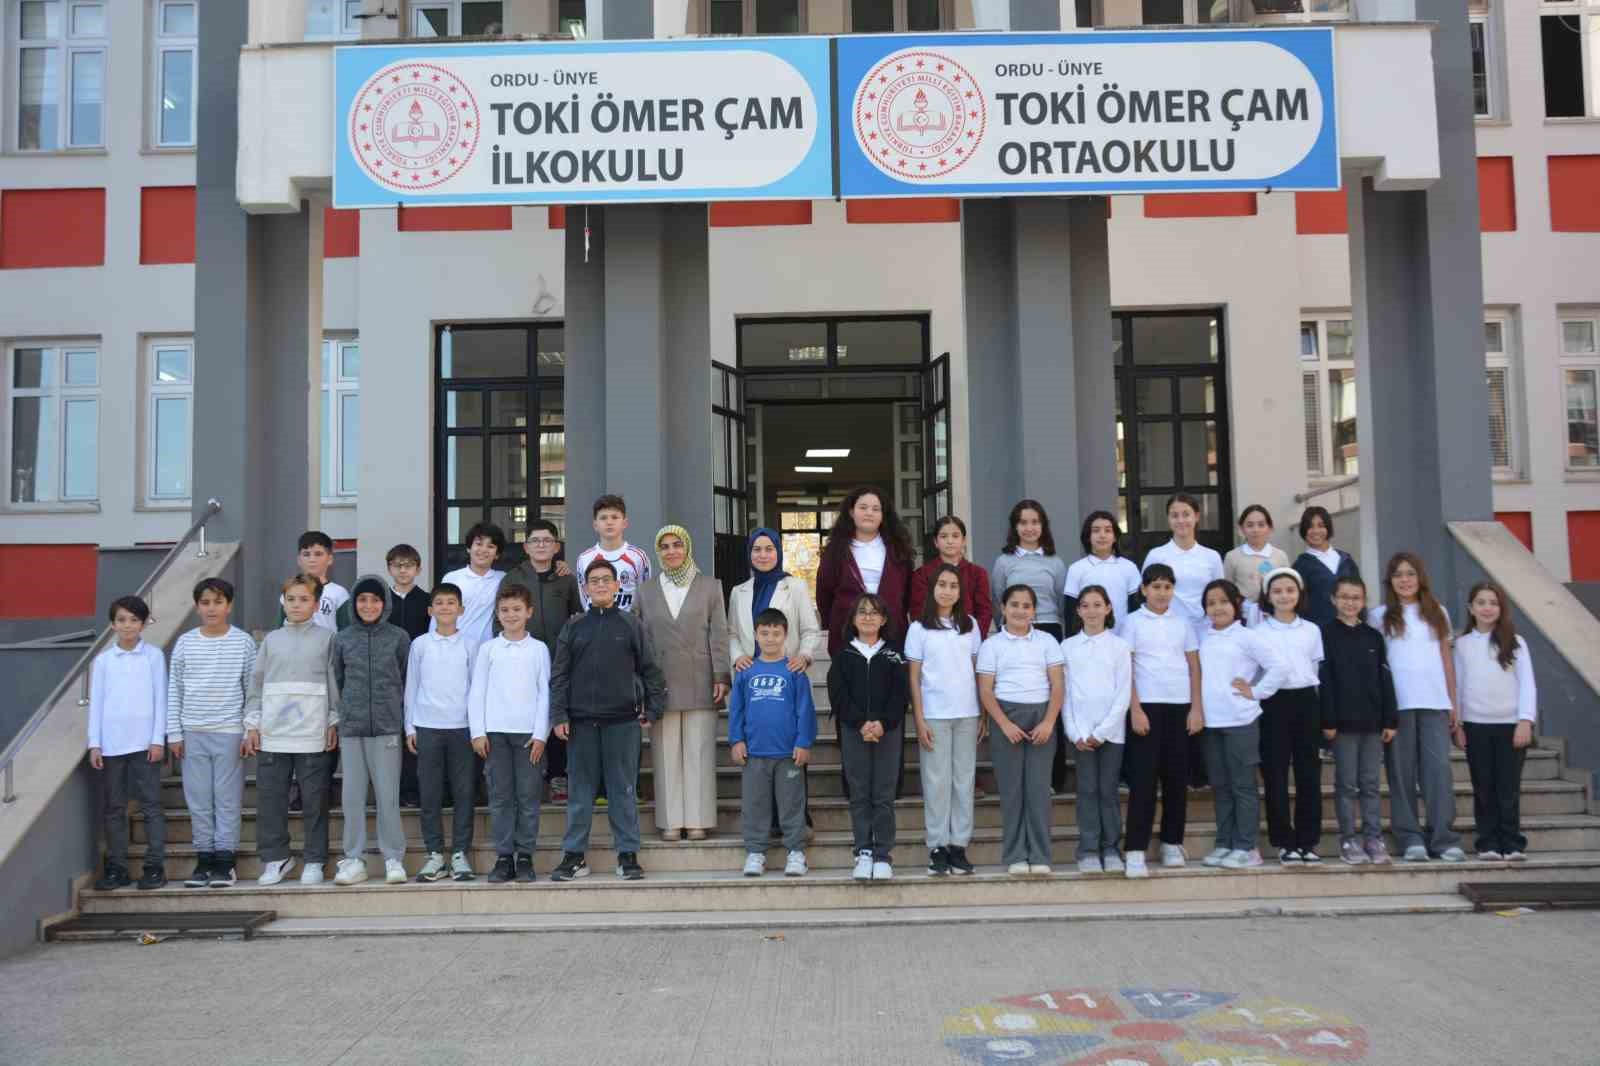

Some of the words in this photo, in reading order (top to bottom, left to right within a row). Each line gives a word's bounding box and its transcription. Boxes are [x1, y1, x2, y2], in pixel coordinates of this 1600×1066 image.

[490, 73, 539, 87] ORDU
[553, 69, 598, 86] ÜNYE
[994, 63, 1044, 77] ORDU
[1058, 59, 1103, 76] ÜNYE
[490, 93, 579, 136] TOKİ
[591, 92, 705, 134] ÖMER
[714, 97, 803, 141] ÇAM
[995, 83, 1085, 126] TOKİ
[1096, 82, 1212, 125] ÖMER
[1221, 88, 1309, 132] ÇAM
[492, 144, 683, 185] İLKOKULU
[998, 139, 1235, 176] ORTAOKULU
